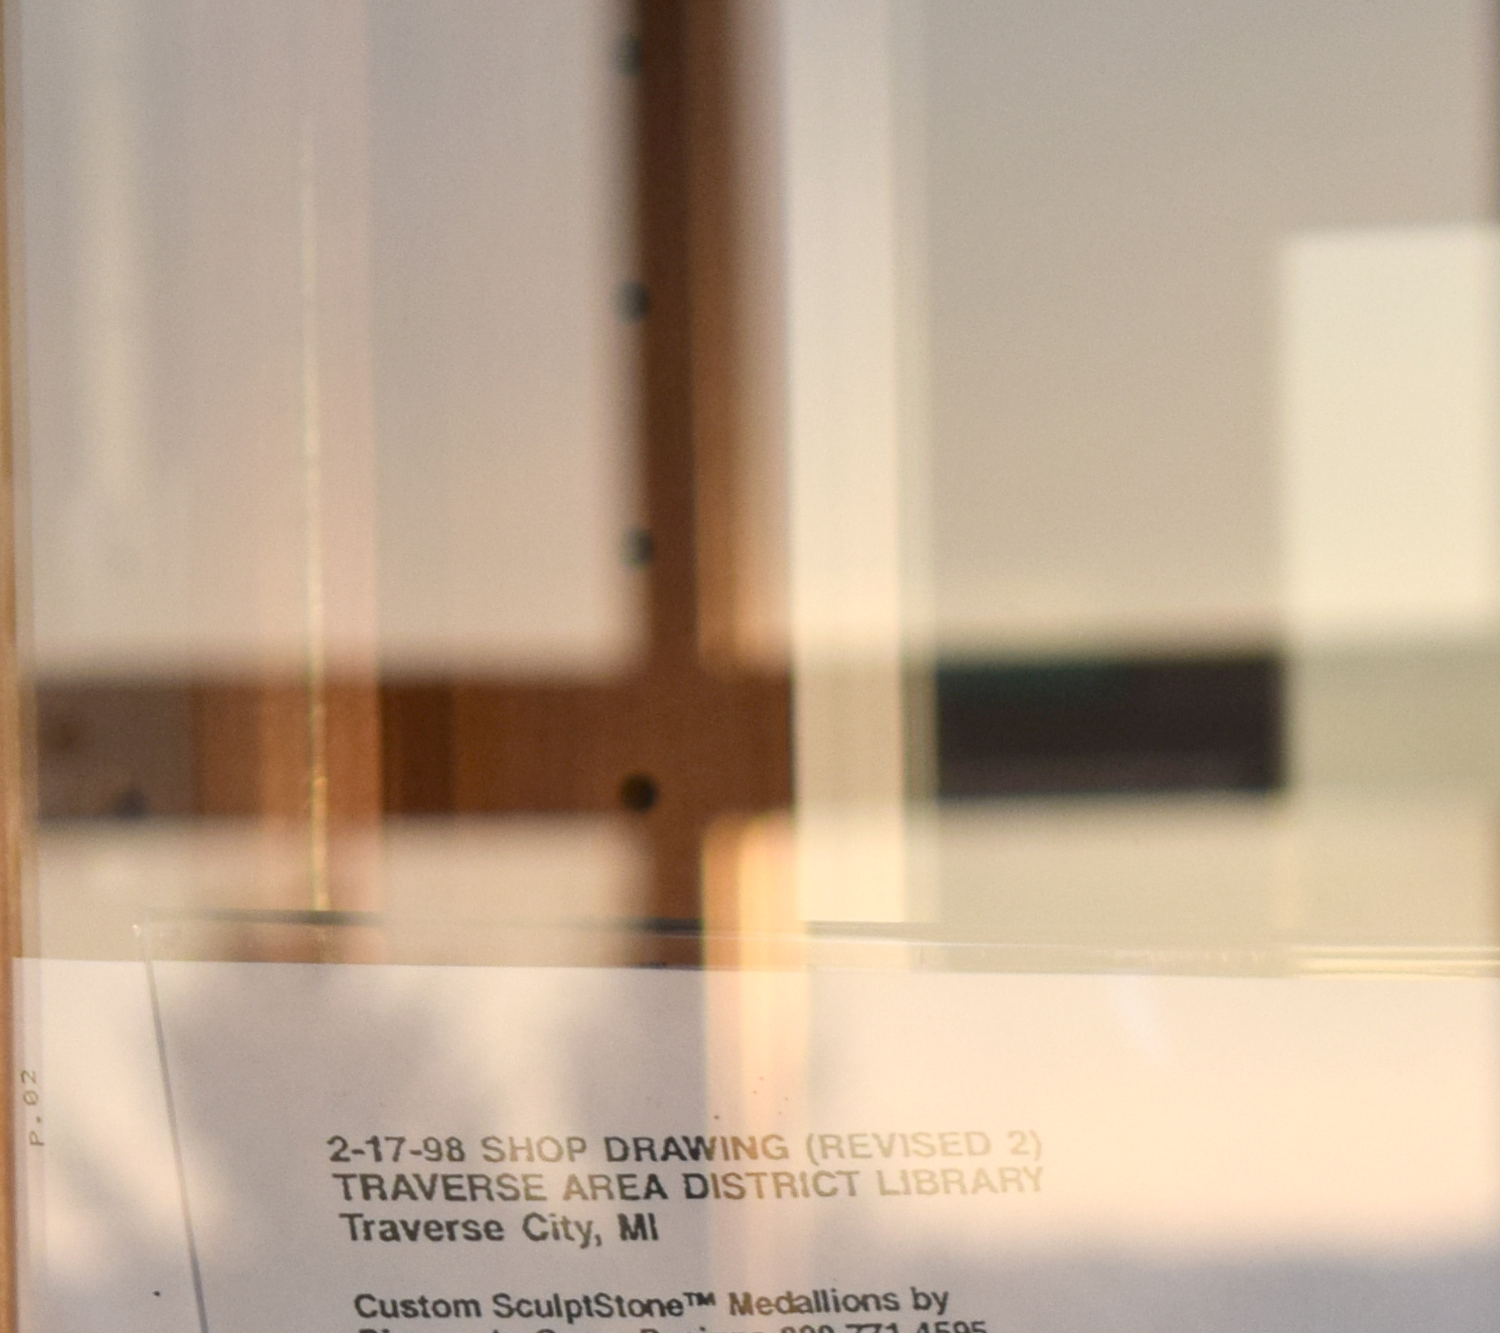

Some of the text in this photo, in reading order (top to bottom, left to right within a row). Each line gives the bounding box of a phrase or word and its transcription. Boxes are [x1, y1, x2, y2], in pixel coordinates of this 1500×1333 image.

[19, 1069, 44, 1146] P.02
[326, 1130, 1043, 1166] 2-17-98 SHOP DRAWING (REVISED 2)
[332, 1166, 1044, 1202] TRAVERSE AREA DISTRICT LIBRARY
[338, 1212, 660, 1250] Traverse City, MI
[354, 1293, 482, 1319] Custom
[728, 1289, 900, 1317] Medallions
[910, 1286, 950, 1316] by
